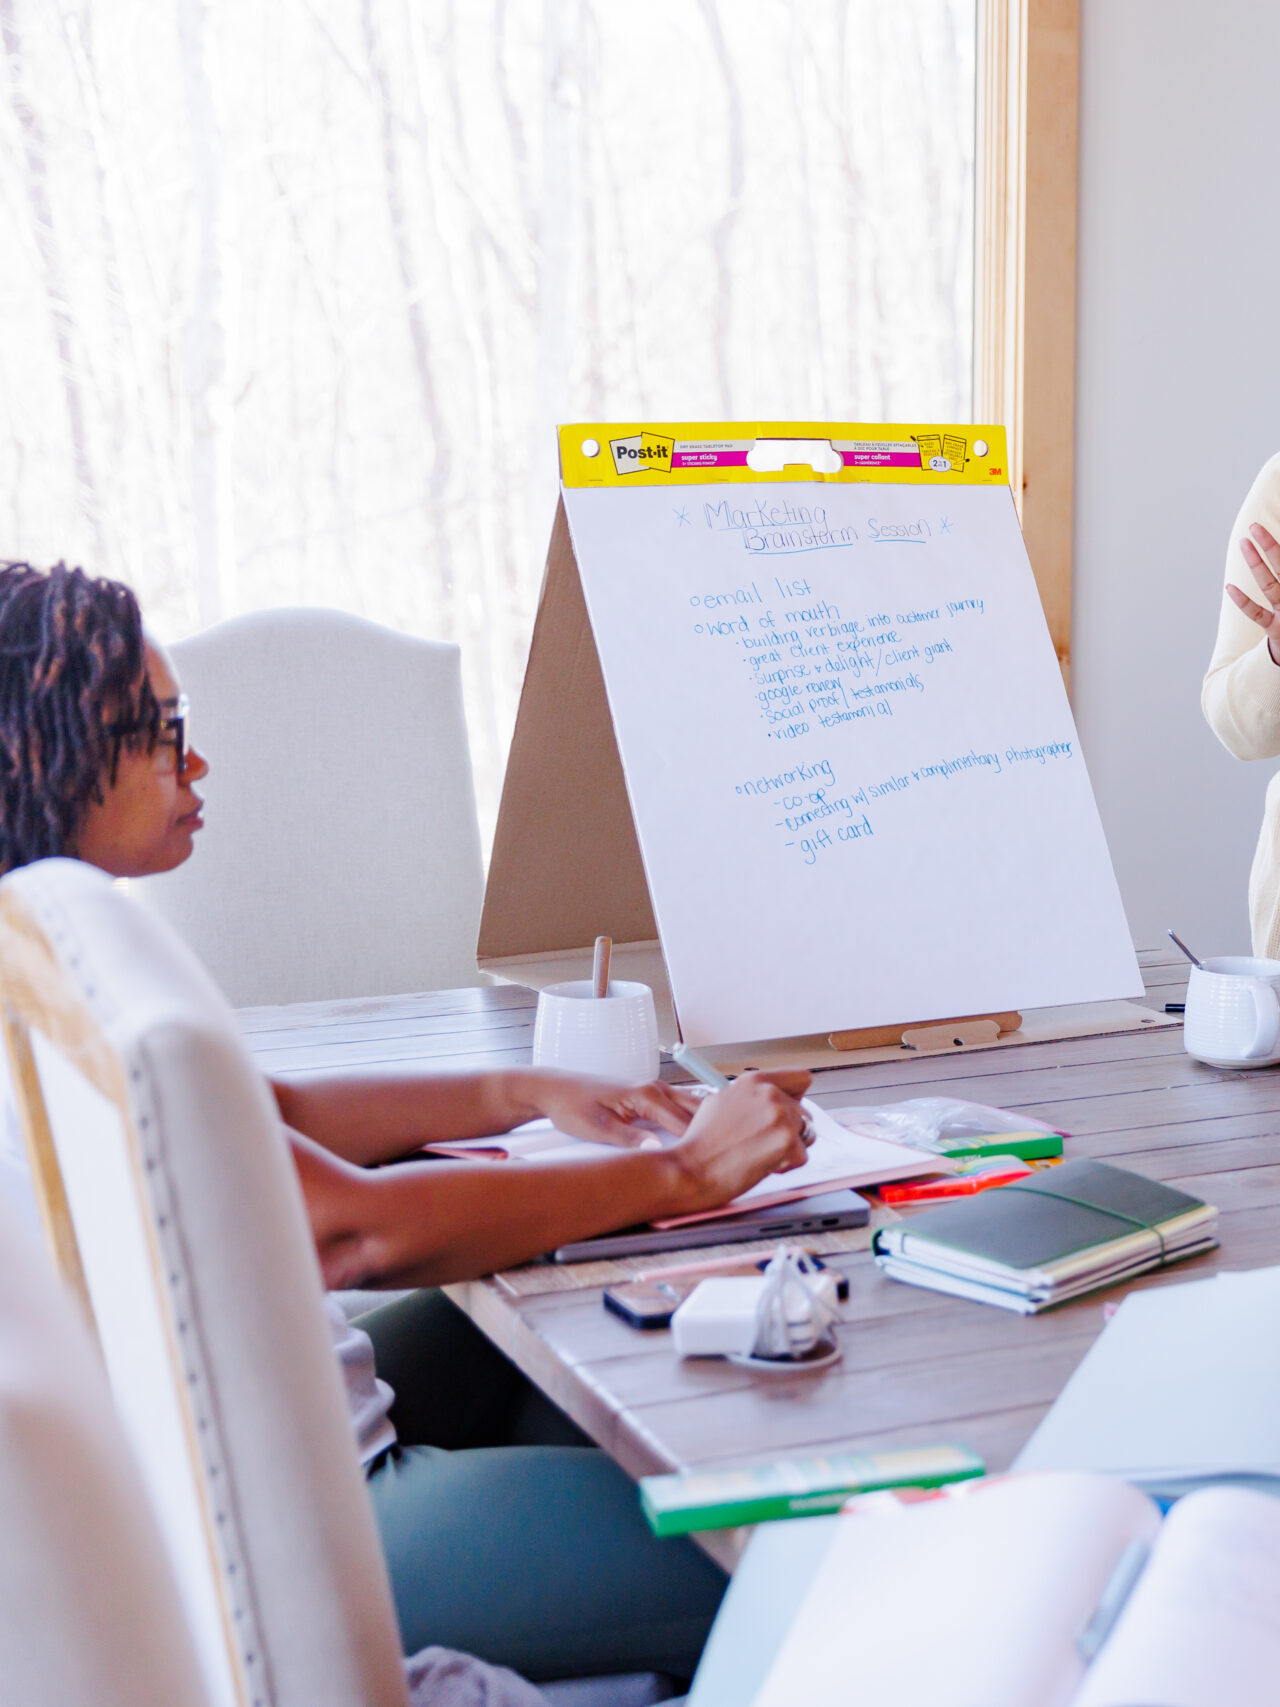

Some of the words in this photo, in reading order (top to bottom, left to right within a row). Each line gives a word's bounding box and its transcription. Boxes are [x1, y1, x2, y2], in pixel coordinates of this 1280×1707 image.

[989, 468, 1001, 476] 3M
[703, 499, 827, 528] Marketing
[744, 525, 859, 551] Brainstorm
[867, 517, 932, 539] Session
[703, 581, 763, 608] email
[775, 577, 812, 599] list
[706, 615, 750, 636] word
[758, 610, 776, 628] of
[784, 600, 841, 623] mouth
[741, 630, 802, 650] building
[805, 620, 865, 640] verbiage
[867, 612, 891, 627] into
[749, 649, 782, 672] great
[790, 643, 830, 658] client
[754, 664, 811, 685] surprise
[758, 684, 803, 710] google
[765, 701, 805, 725] social
[773, 722, 810, 740] video
[743, 759, 836, 796] networking
[868, 775, 910, 799] similar
[800, 828, 834, 865] gift
[837, 814, 874, 842] card
